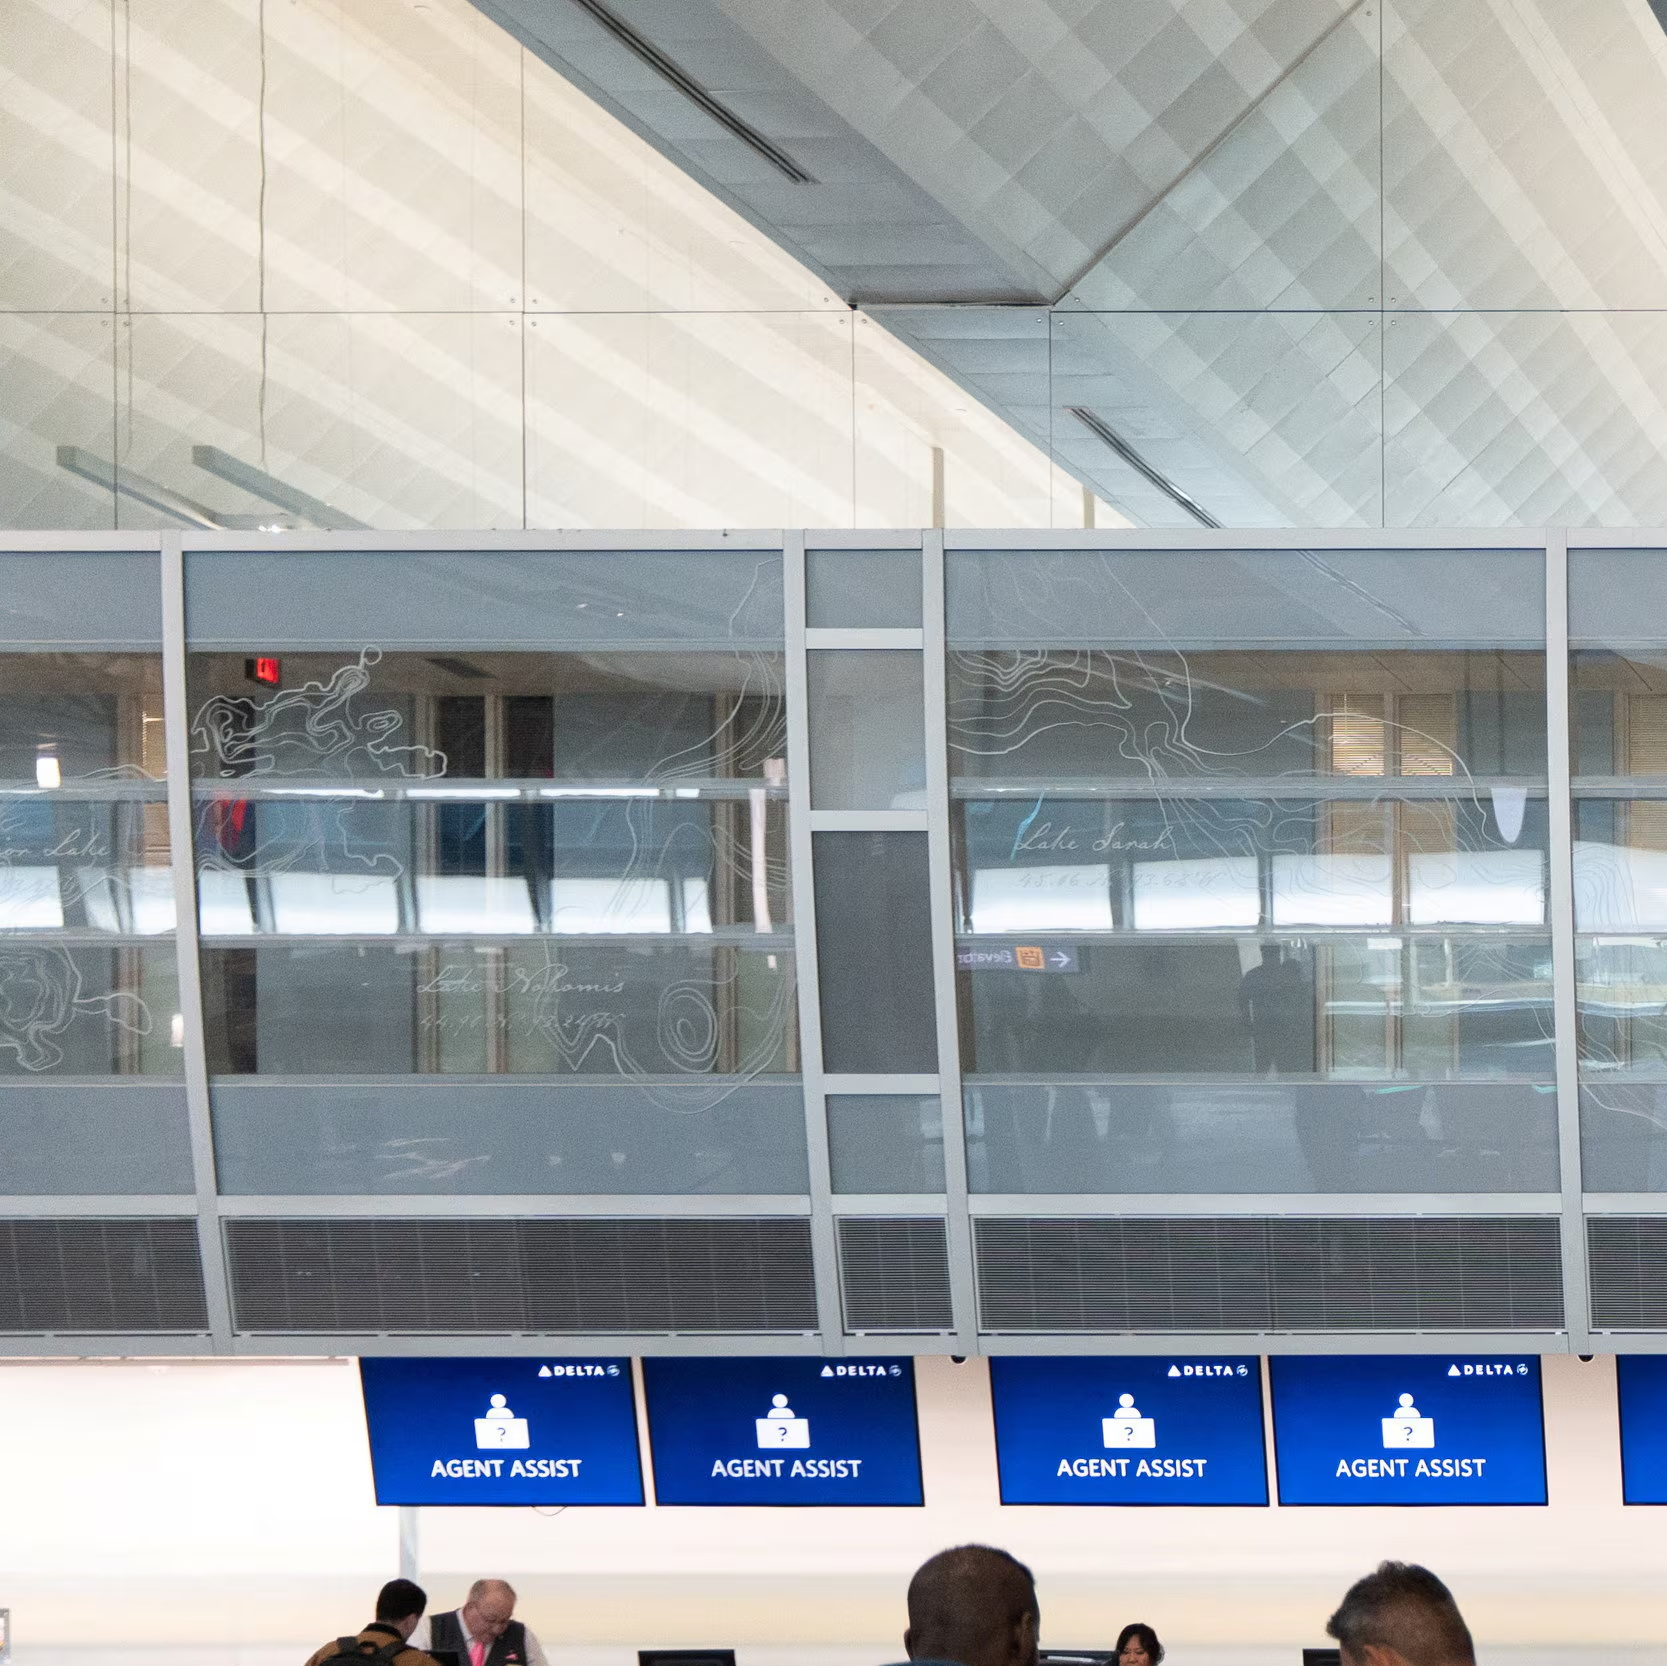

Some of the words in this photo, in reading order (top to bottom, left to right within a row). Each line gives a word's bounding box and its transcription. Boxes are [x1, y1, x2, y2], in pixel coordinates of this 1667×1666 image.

[43, 828, 110, 857] Lake
[1016, 822, 1078, 850] Lake
[1093, 821, 1174, 851] Sarah
[554, 1366, 604, 1376] DELTA
[833, 1366, 886, 1376] DELTA
[1184, 1366, 1233, 1376] DELTA
[1464, 1365, 1513, 1375] DELTA
[431, 1460, 504, 1477] AGENT
[510, 1460, 582, 1477] ASSIST
[712, 1460, 784, 1477] AGENT
[791, 1460, 862, 1477] ASSIST
[1057, 1459, 1130, 1477] AGENT
[1136, 1459, 1207, 1477] ASSIST
[1336, 1459, 1409, 1477] AGENT
[1415, 1459, 1486, 1477] ASSIST
